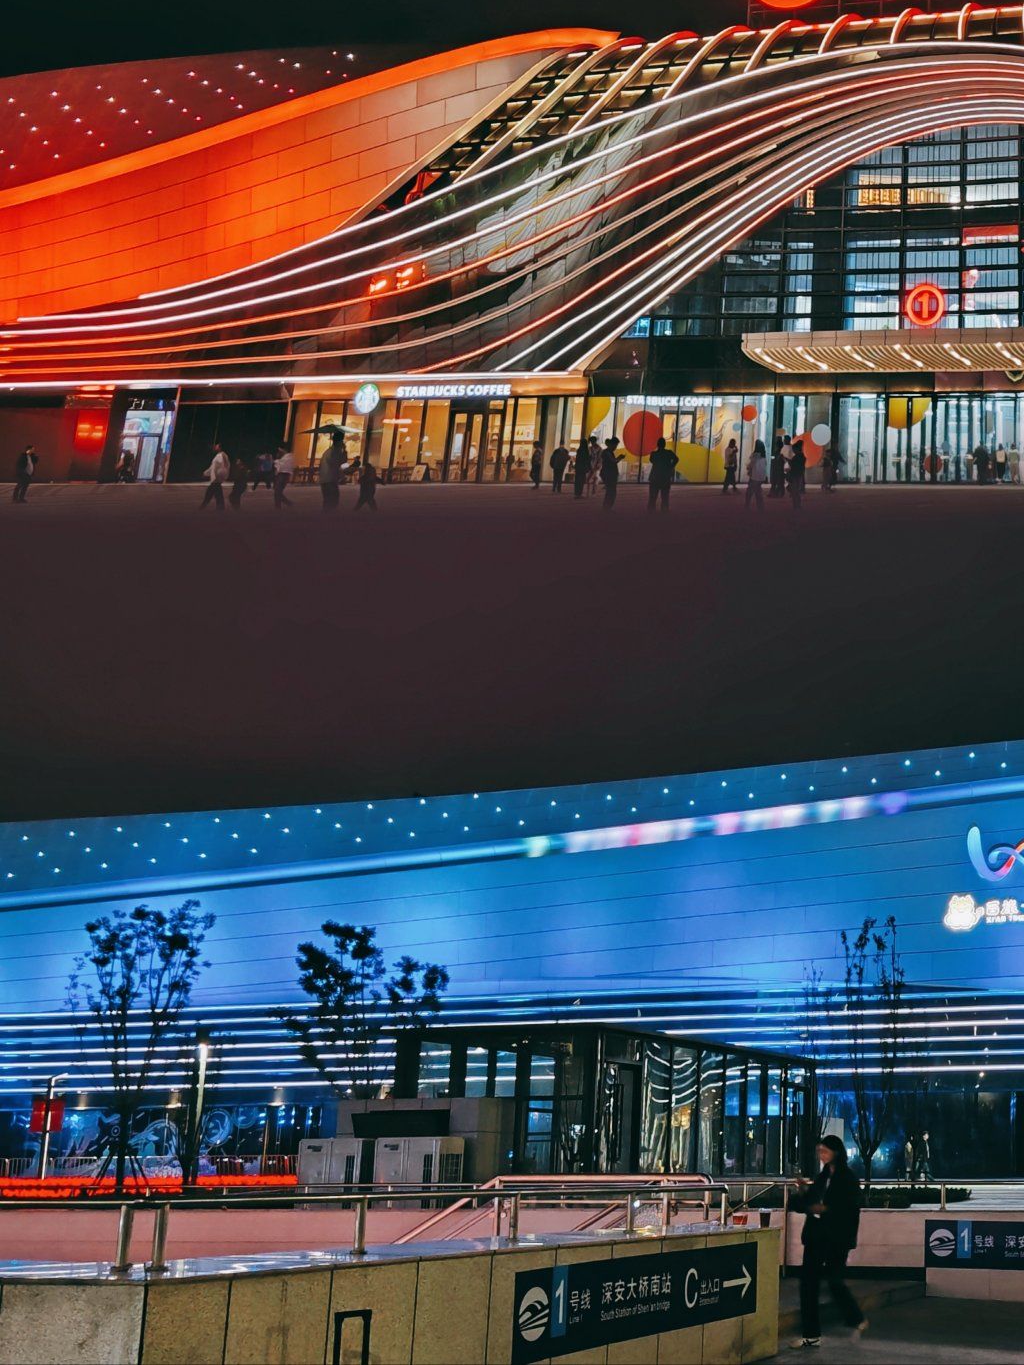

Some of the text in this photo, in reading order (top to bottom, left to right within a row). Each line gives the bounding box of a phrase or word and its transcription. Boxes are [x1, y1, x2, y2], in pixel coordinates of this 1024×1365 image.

[396, 383, 512, 397] STARBUCKS COFFEE
[959, 1227, 995, 1252] 1 号线
[600, 1272, 672, 1305] 深安大桥南站
[684, 1267, 698, 1309] C
[700, 1277, 721, 1296] 出入口
[554, 1279, 591, 1324] 1 号线
[600, 1309, 615, 1322] South
[615, 1306, 632, 1319] Station
